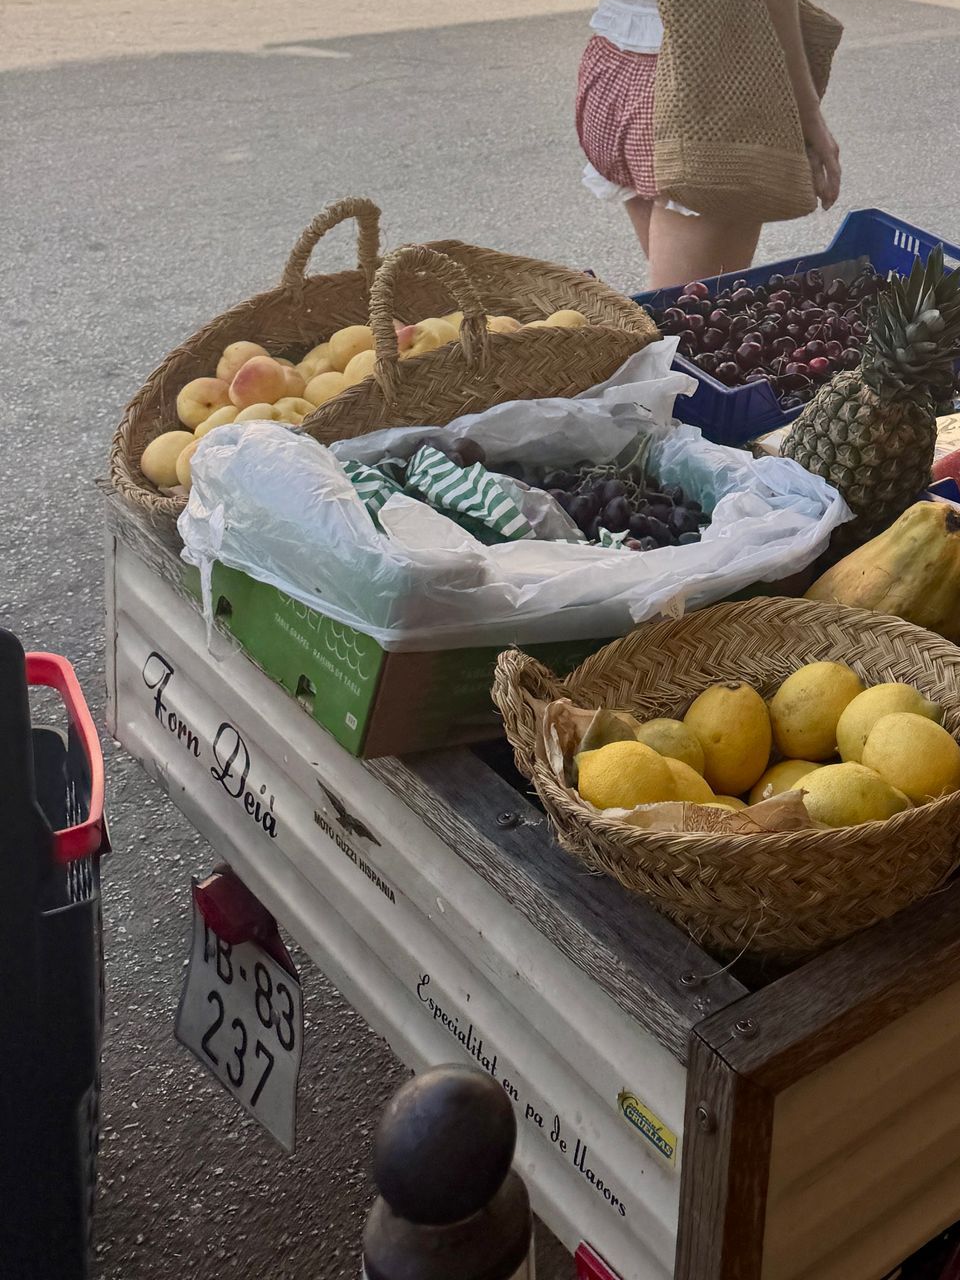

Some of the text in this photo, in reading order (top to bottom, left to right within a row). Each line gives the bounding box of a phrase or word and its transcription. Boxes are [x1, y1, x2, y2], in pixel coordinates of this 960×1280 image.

[142, 651, 201, 758] Forn
[313, 810, 396, 905] MOTO GUZZI HISPANIA
[201, 990, 275, 1107] 237
[416, 973, 627, 1217] Especialitat en pa de llavors
